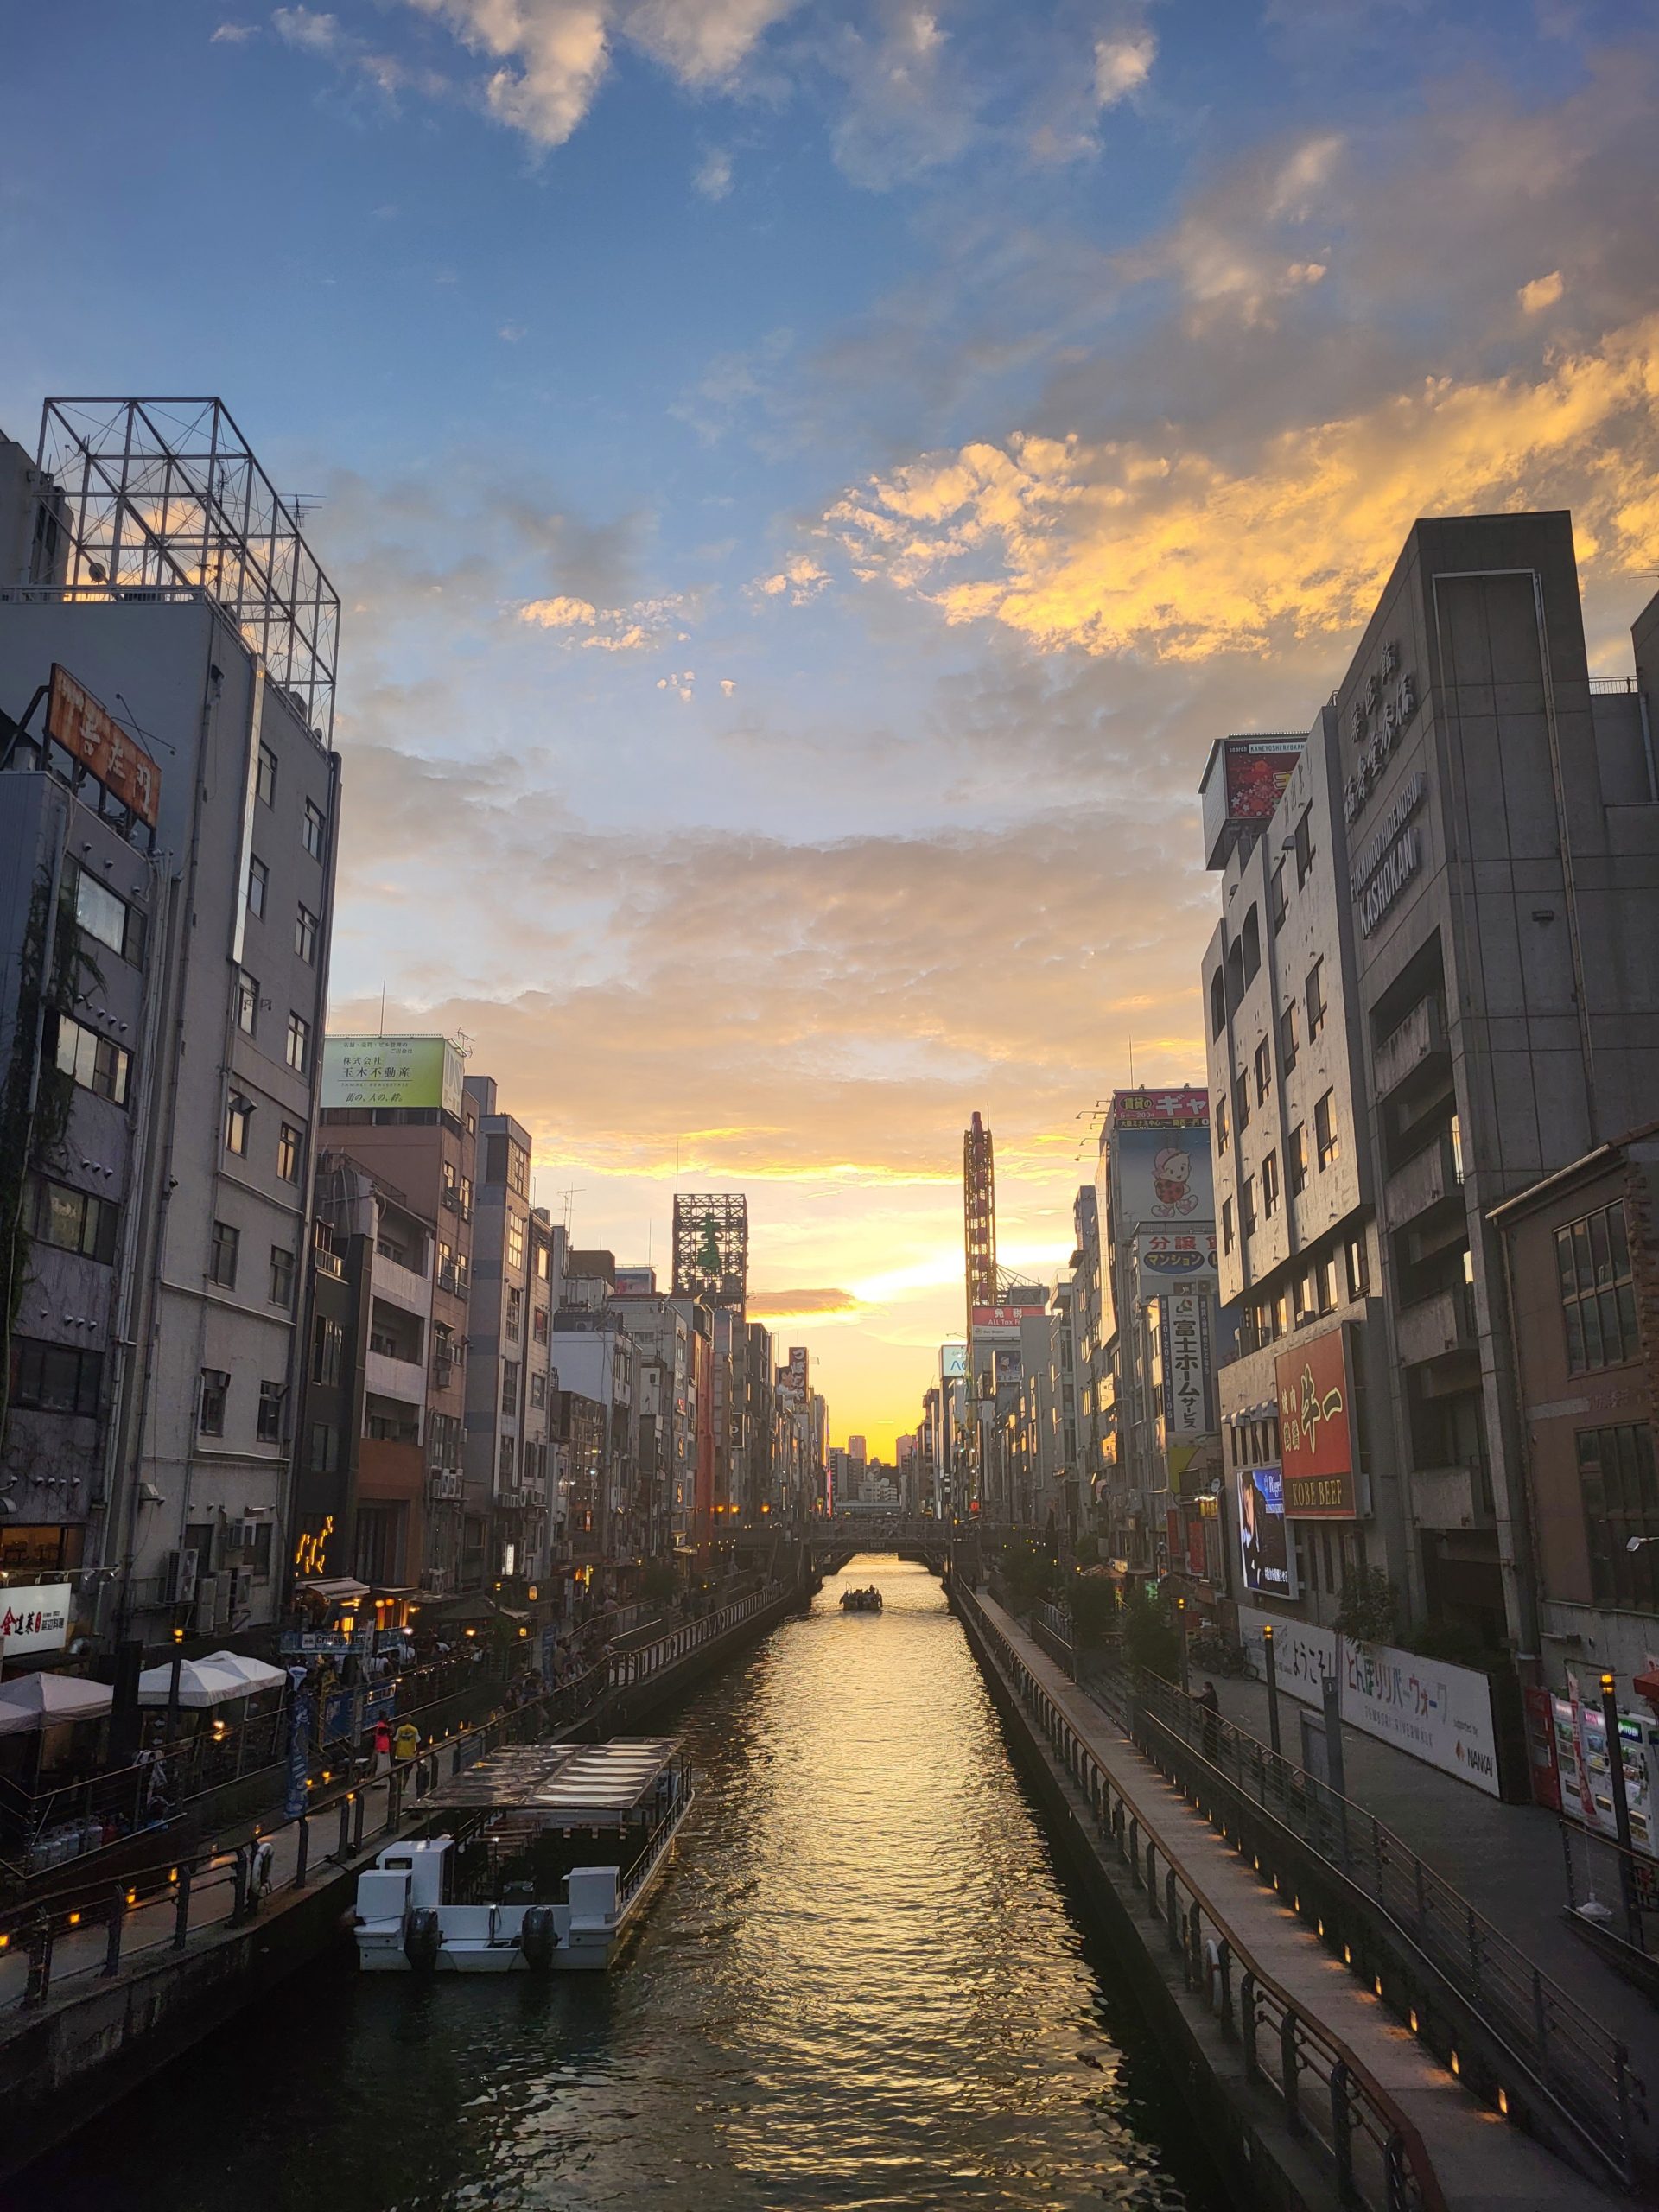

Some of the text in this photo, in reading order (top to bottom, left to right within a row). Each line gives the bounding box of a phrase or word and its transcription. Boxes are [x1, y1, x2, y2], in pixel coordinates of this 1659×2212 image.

[1382, 772, 1421, 851] HIDENOBU
[1359, 827, 1417, 940] KASHOKAN
[342, 1066, 411, 1078] 玉木不動産
[343, 1057, 382, 1065] 株式会社
[1148, 1236, 1197, 1250] 分譲
[1147, 1254, 1202, 1266] マンション
[1173, 1319, 1200, 1428] 富士ホームサービス
[1300, 1363, 1343, 1455] 牛一
[1268, 1474, 1282, 1497] Rigel
[1292, 1478, 1342, 1507] KOBE BEEF
[1466, 1746, 1494, 1777] NANKAI
